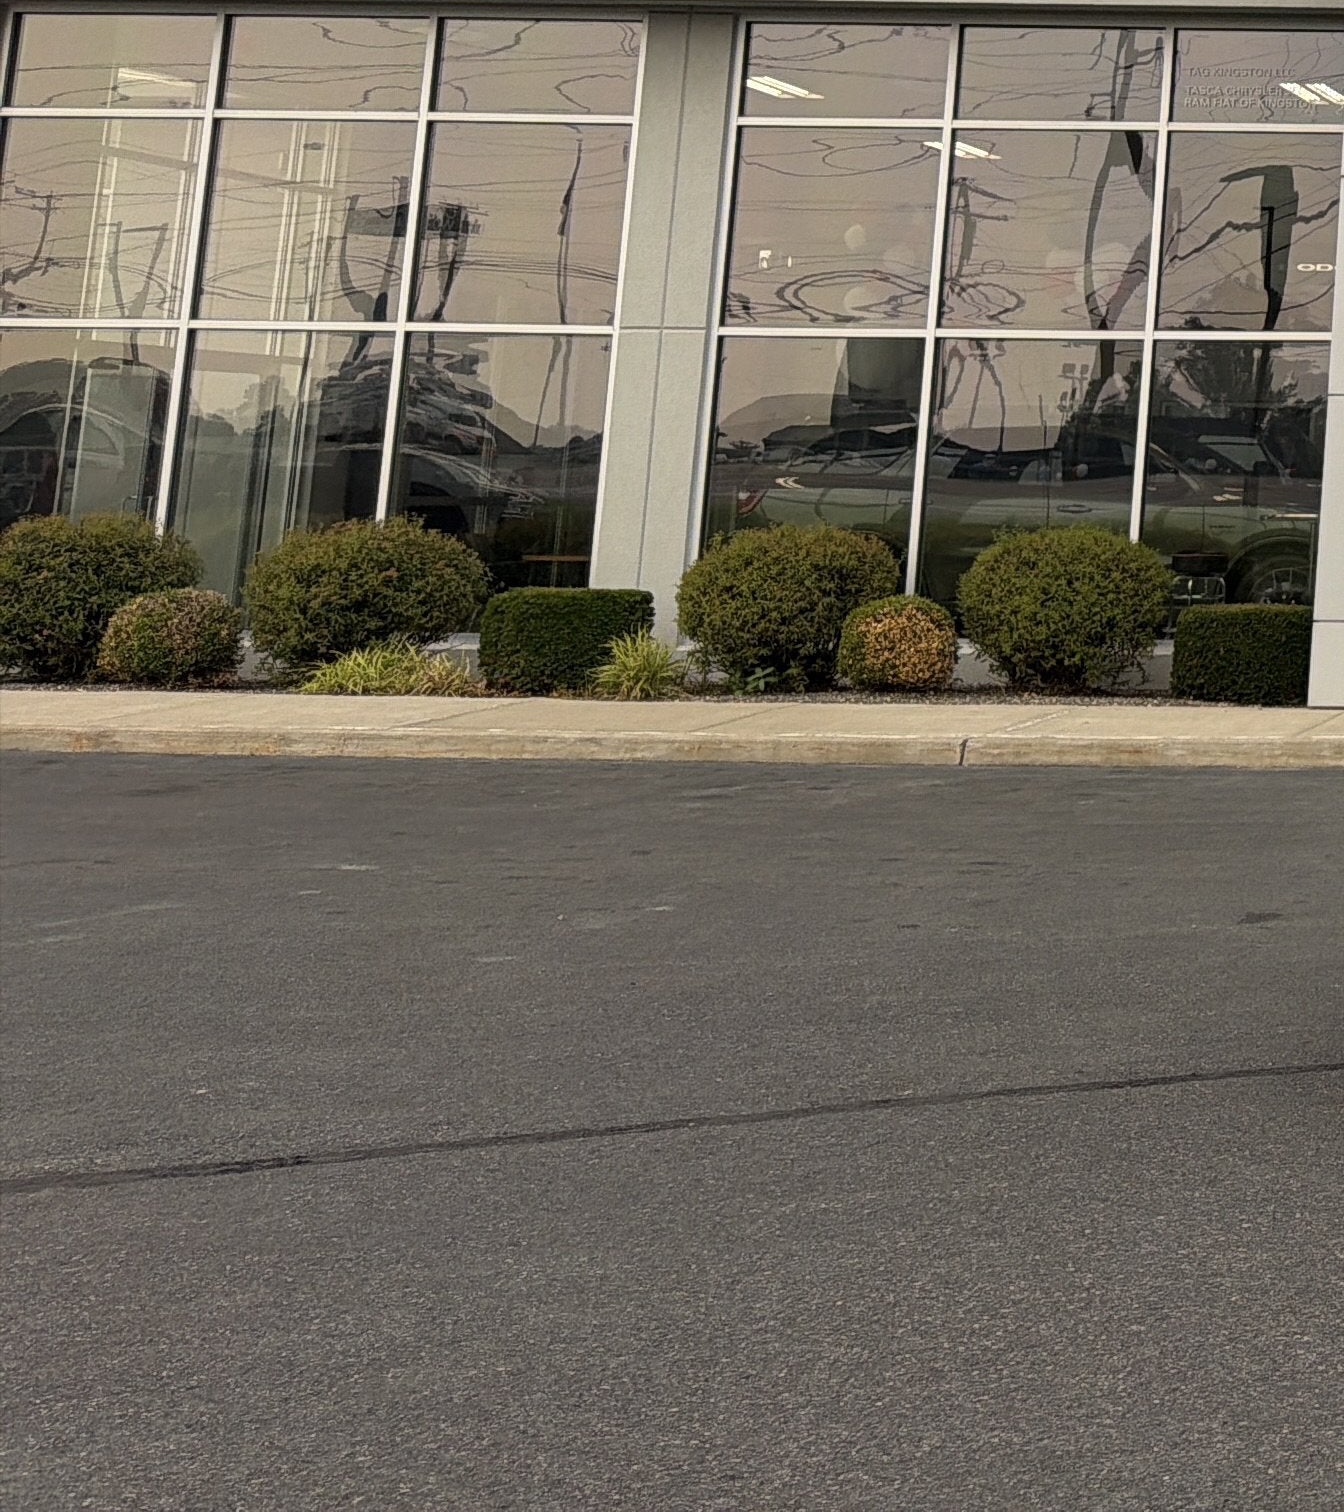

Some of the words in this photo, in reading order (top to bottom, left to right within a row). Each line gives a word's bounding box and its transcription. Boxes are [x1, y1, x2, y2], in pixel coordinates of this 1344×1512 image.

[1213, 67, 1273, 78] KINGSTON
[1185, 85, 1224, 97] TASCA
[1184, 97, 1212, 109] RAM
[1214, 97, 1238, 109] FIAT
[1240, 98, 1258, 109] OF
